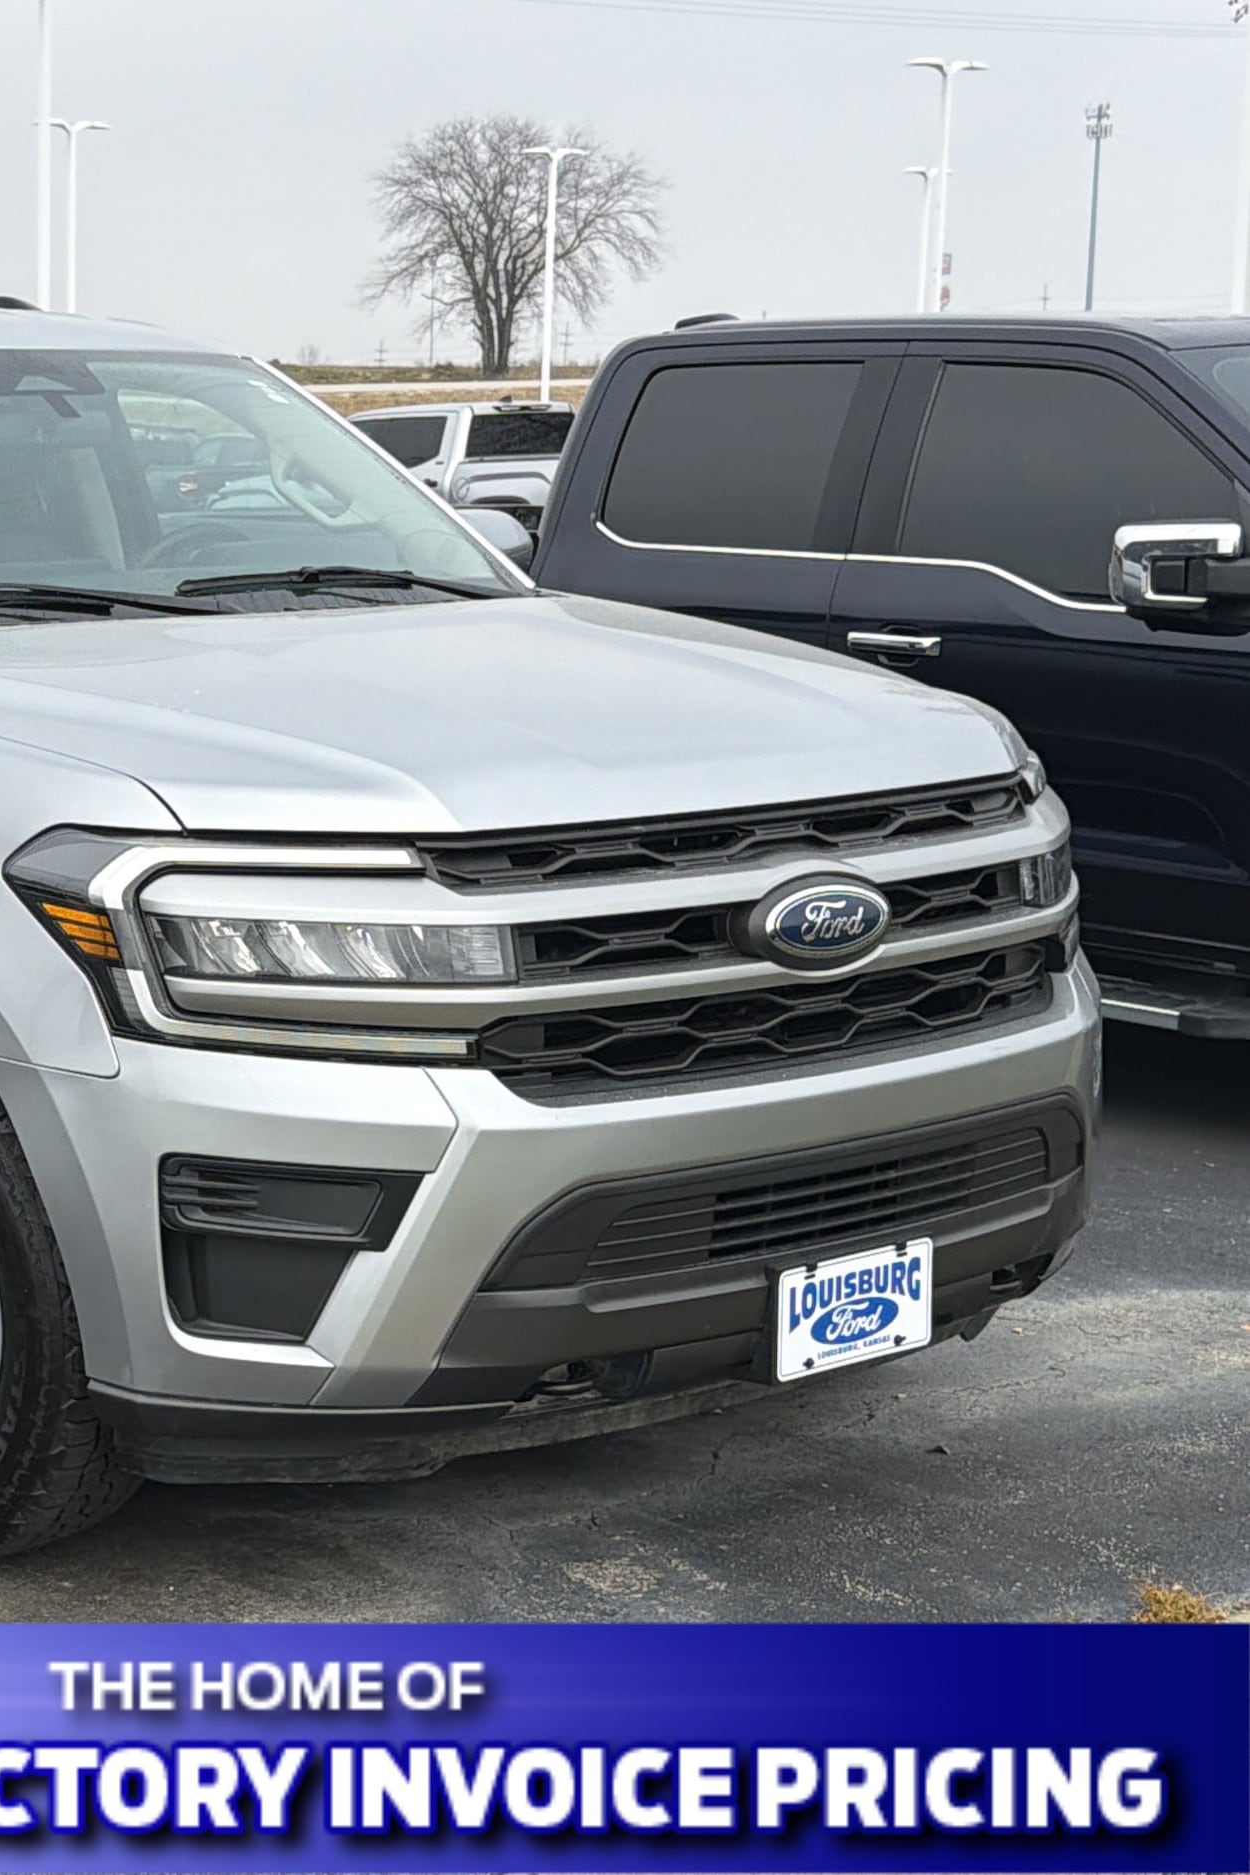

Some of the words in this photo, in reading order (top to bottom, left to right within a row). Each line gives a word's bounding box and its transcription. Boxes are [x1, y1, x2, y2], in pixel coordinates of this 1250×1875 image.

[802, 901, 864, 942] Ford
[789, 1256, 921, 1334] LOUISBURG
[826, 1301, 883, 1340] Ford
